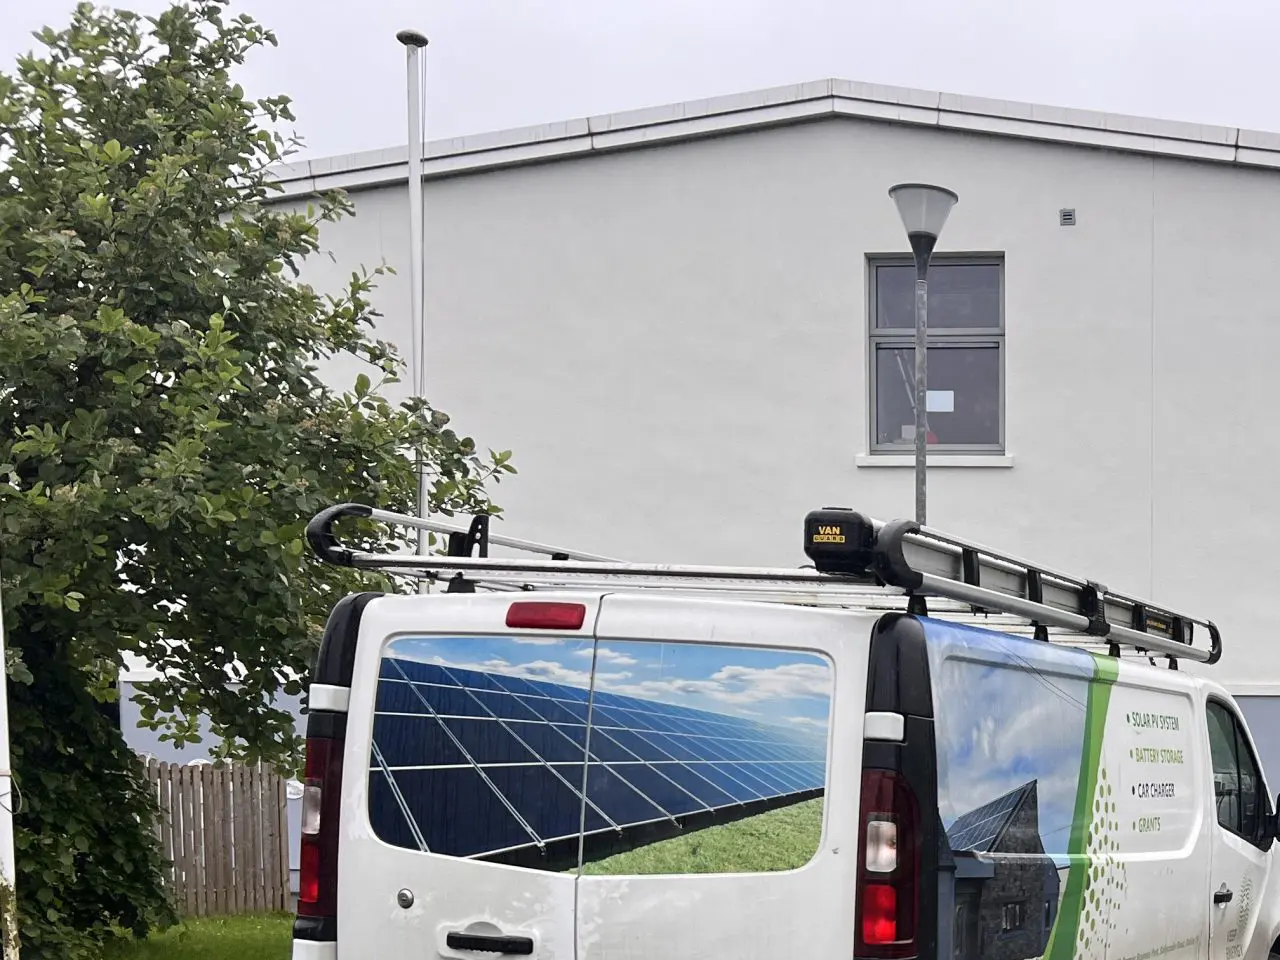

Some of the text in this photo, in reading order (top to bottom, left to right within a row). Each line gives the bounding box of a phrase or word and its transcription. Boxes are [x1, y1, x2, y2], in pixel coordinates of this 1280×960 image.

[819, 526, 840, 535] VAN
[813, 535, 845, 543] GUARD
[1132, 711, 1180, 731] SOLAR PV SYSTEM
[1135, 748, 1184, 764] BATTERY STORAGE
[1138, 783, 1175, 798] CAR CHARGER
[1138, 817, 1161, 832] GRANTS
